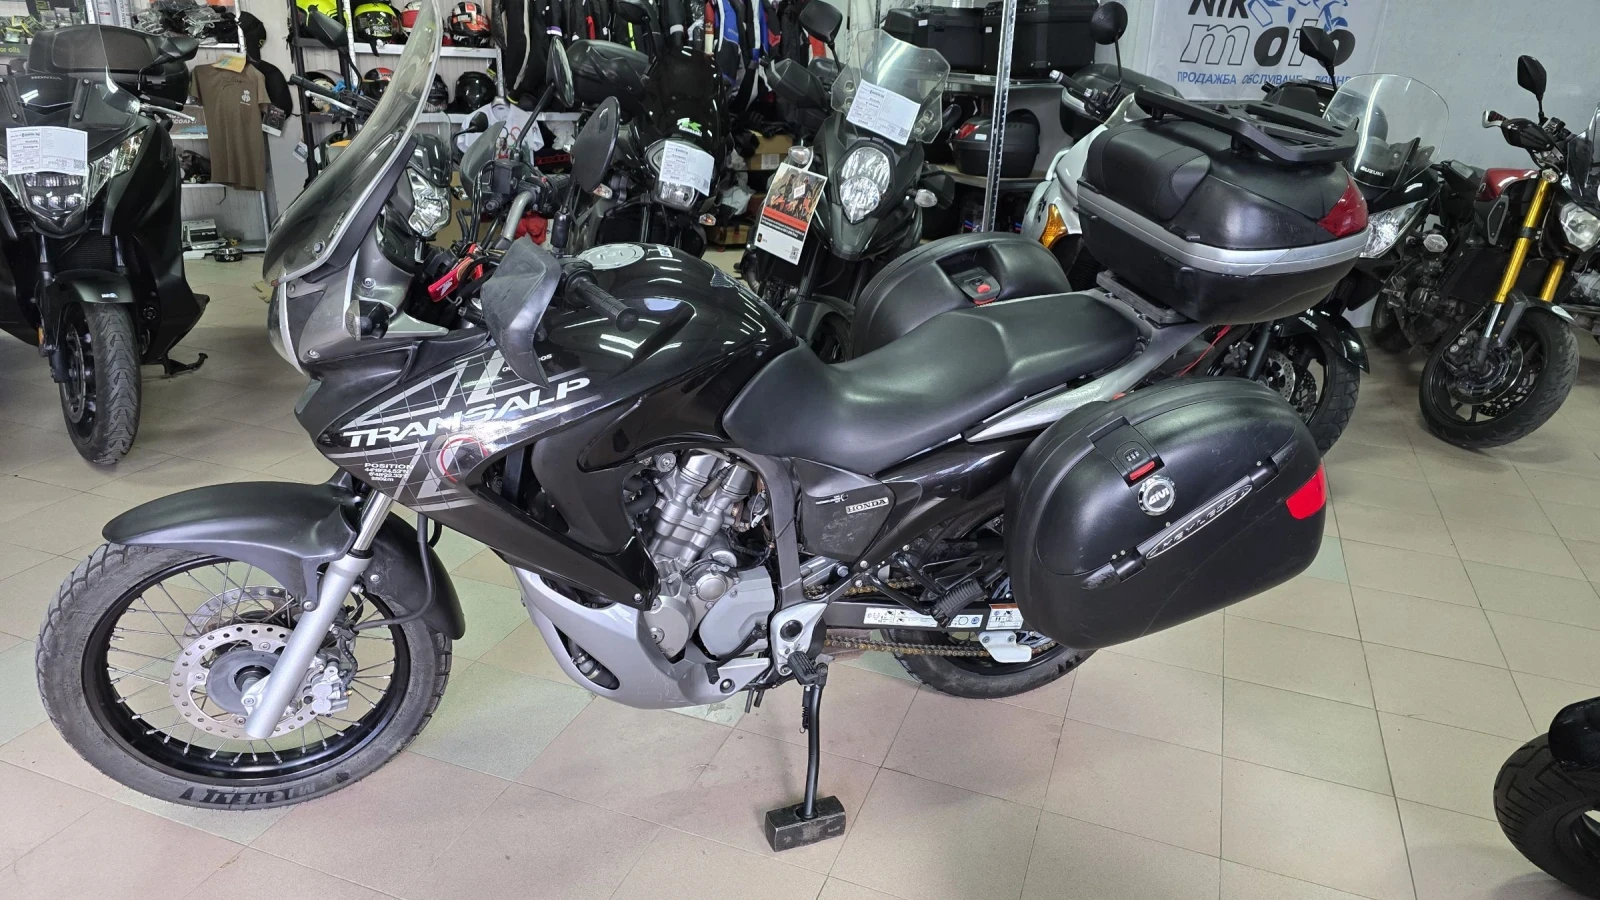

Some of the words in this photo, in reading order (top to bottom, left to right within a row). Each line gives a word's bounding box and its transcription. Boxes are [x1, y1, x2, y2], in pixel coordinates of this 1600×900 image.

[1177, 71, 1237, 85] ПРОДАЖБА
[1360, 165, 1385, 177] SUZUKI
[343, 377, 590, 448] TRANSALP
[364, 462, 414, 470] POSITION
[1148, 487, 1170, 505] GIVI
[847, 498, 887, 513] HONDA
